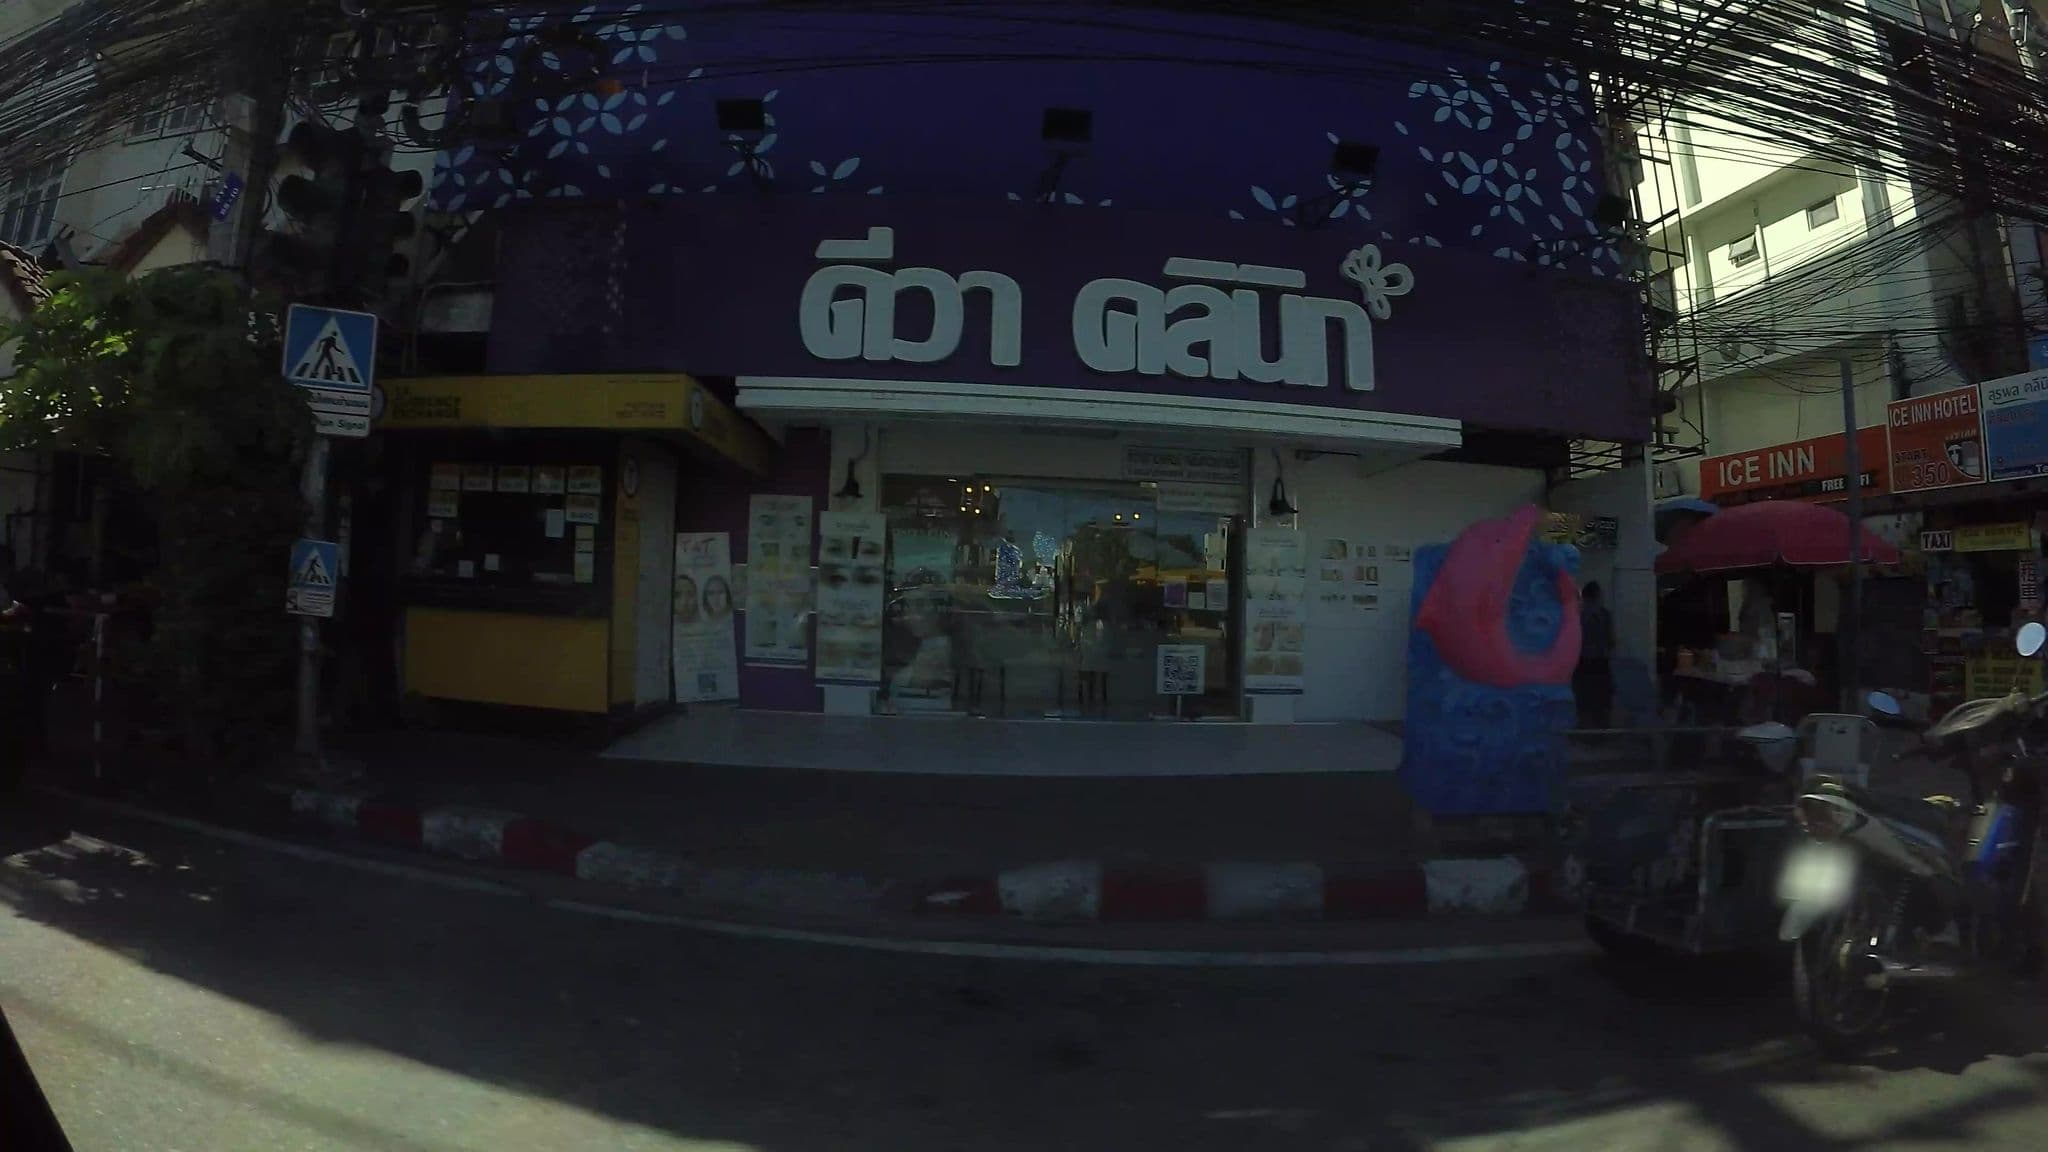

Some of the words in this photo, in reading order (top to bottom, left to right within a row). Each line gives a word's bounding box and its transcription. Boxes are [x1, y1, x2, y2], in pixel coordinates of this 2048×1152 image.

[1072, 256, 1376, 391] คลินิก
[1889, 406, 1909, 428] ICE
[1912, 401, 1932, 424] INN
[1934, 394, 1977, 420] HOTEL
[1719, 455, 1761, 487] ICE
[1768, 445, 1816, 480] INN
[1911, 461, 1950, 489] 350
[1821, 477, 1845, 492] FREE
[1922, 532, 1952, 549] TAXI
